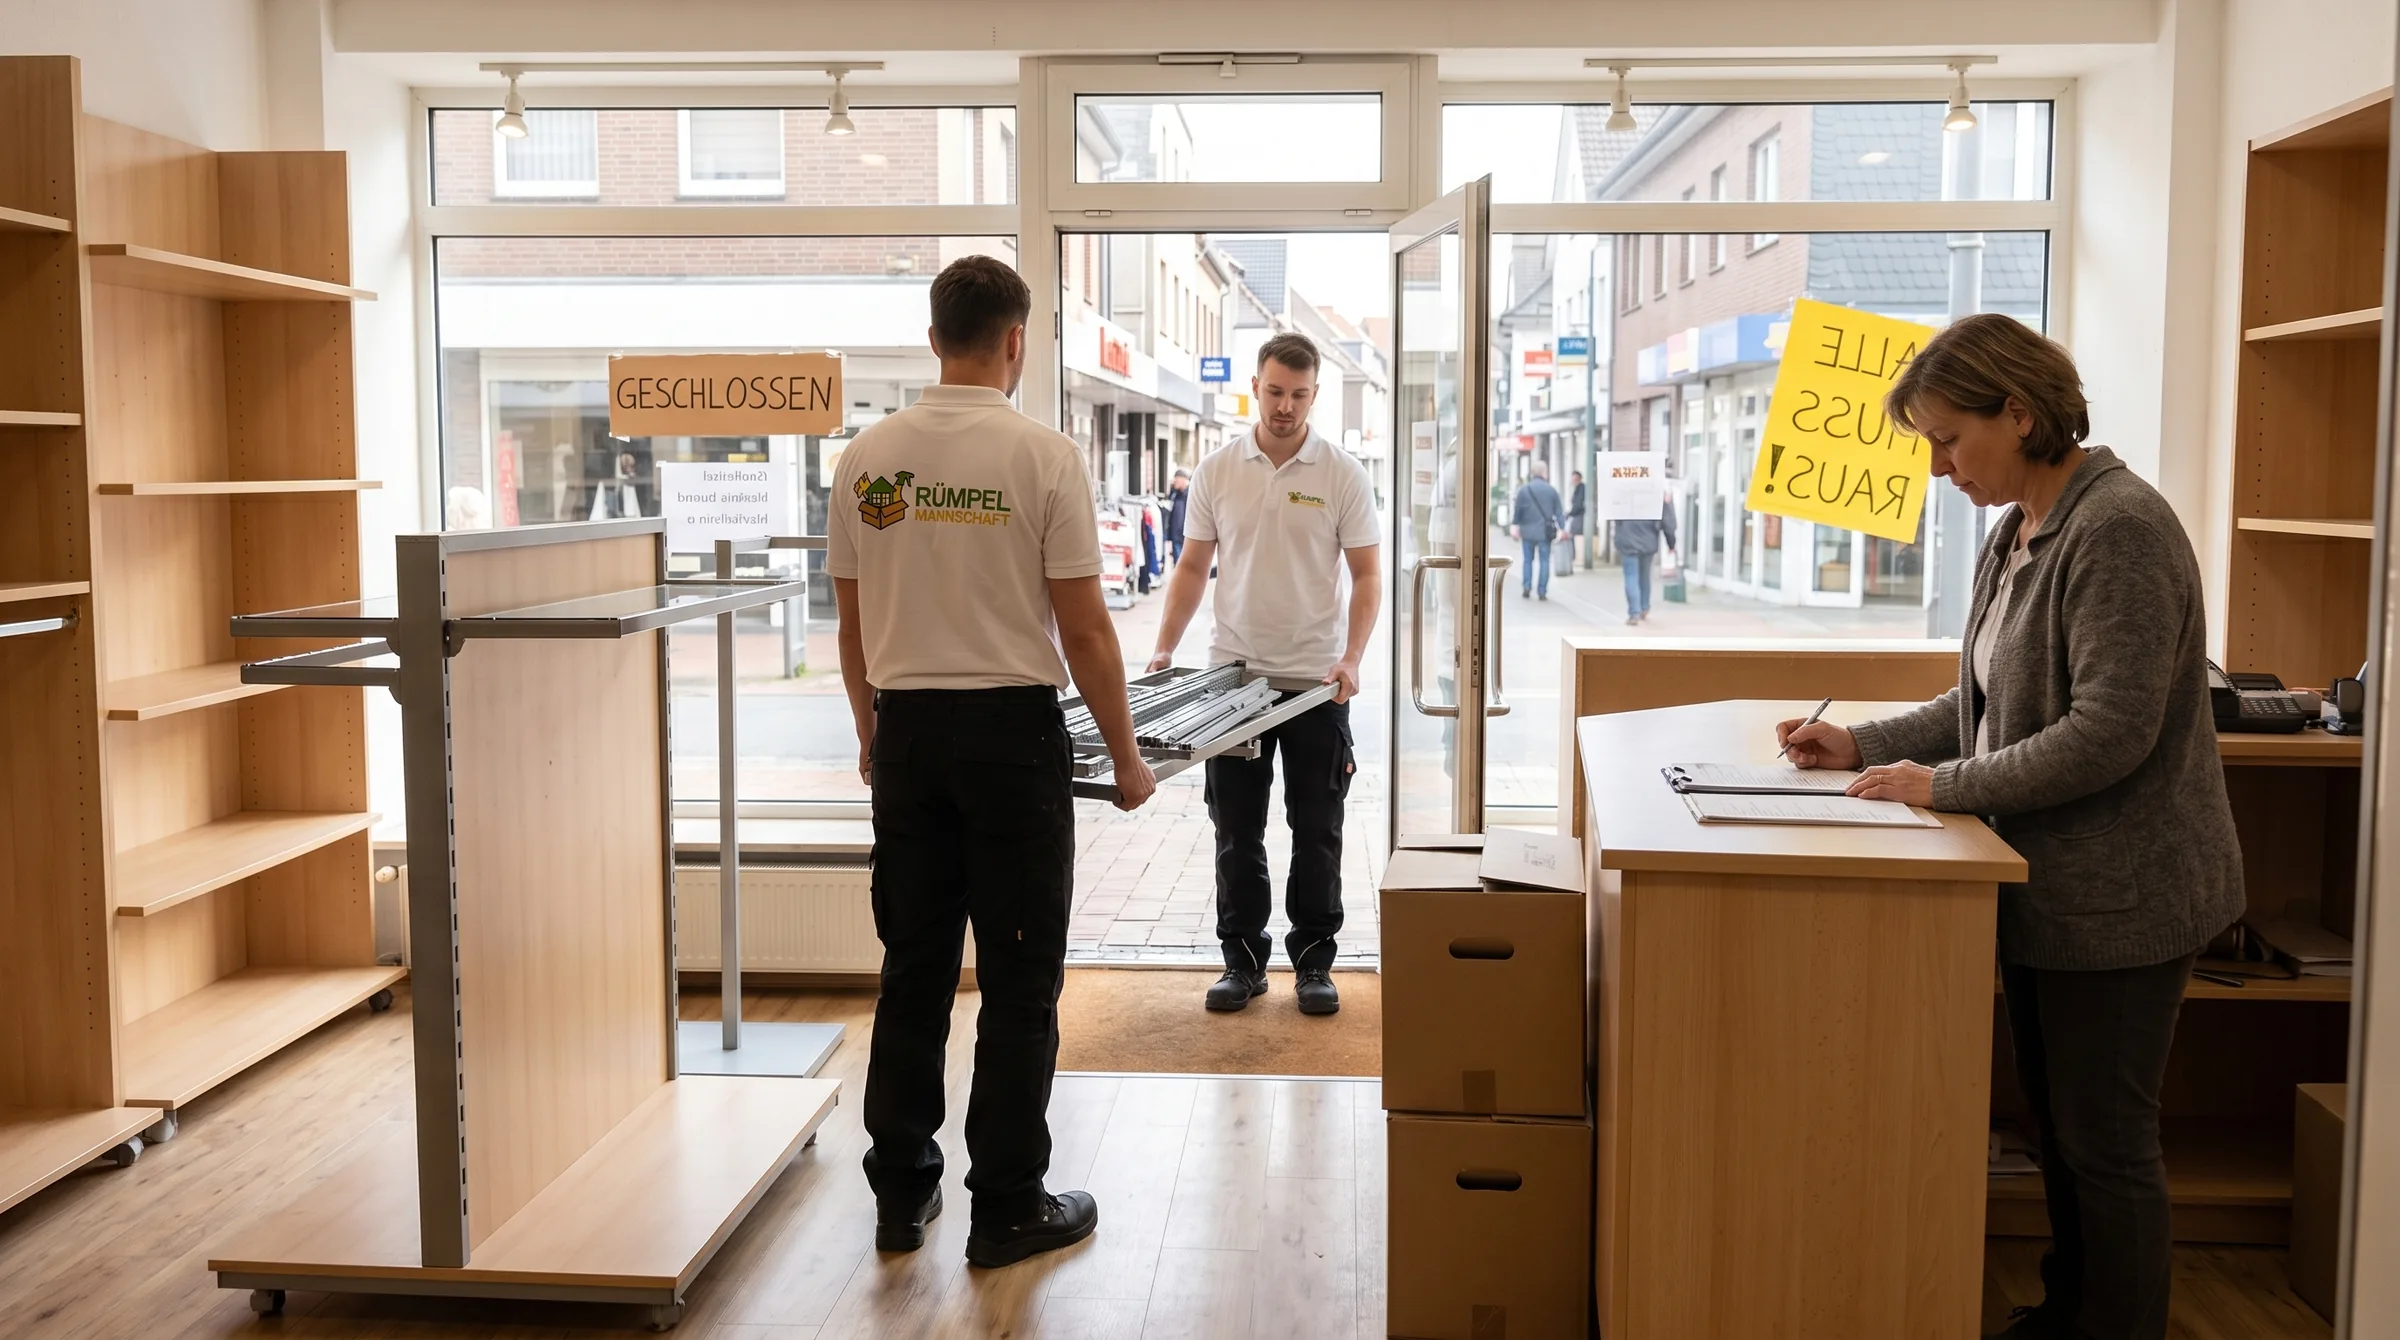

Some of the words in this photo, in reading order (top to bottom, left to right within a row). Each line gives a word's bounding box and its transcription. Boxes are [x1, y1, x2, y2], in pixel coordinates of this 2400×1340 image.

[616, 376, 832, 411] GESCHLOSSEN
[915, 482, 1011, 512] RÜMPEL
[914, 509, 1011, 527] MANNSCHAFT
